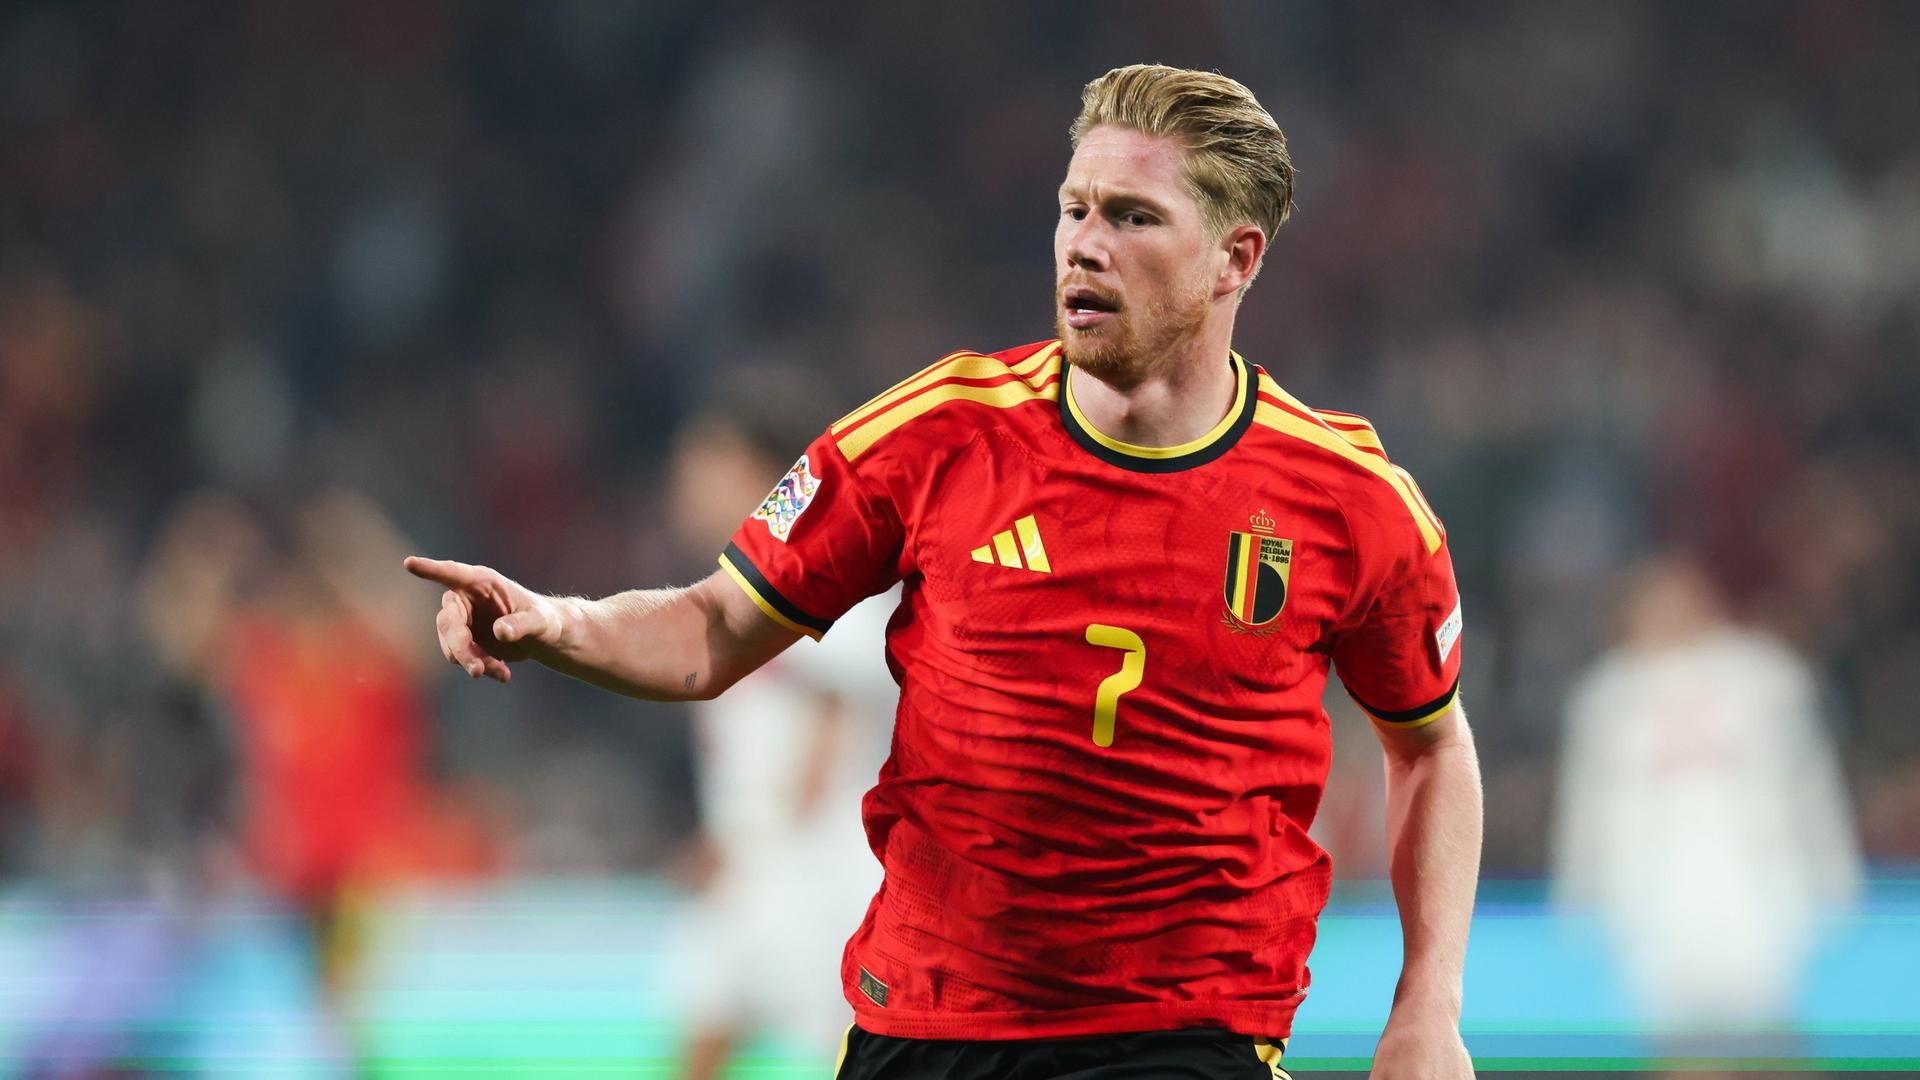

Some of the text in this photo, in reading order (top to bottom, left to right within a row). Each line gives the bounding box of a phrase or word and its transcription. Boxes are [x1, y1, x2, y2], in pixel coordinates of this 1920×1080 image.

[1261, 539, 1283, 548] ROYAL
[1260, 546, 1290, 556] BELGIAN
[1085, 623, 1146, 748] 7
